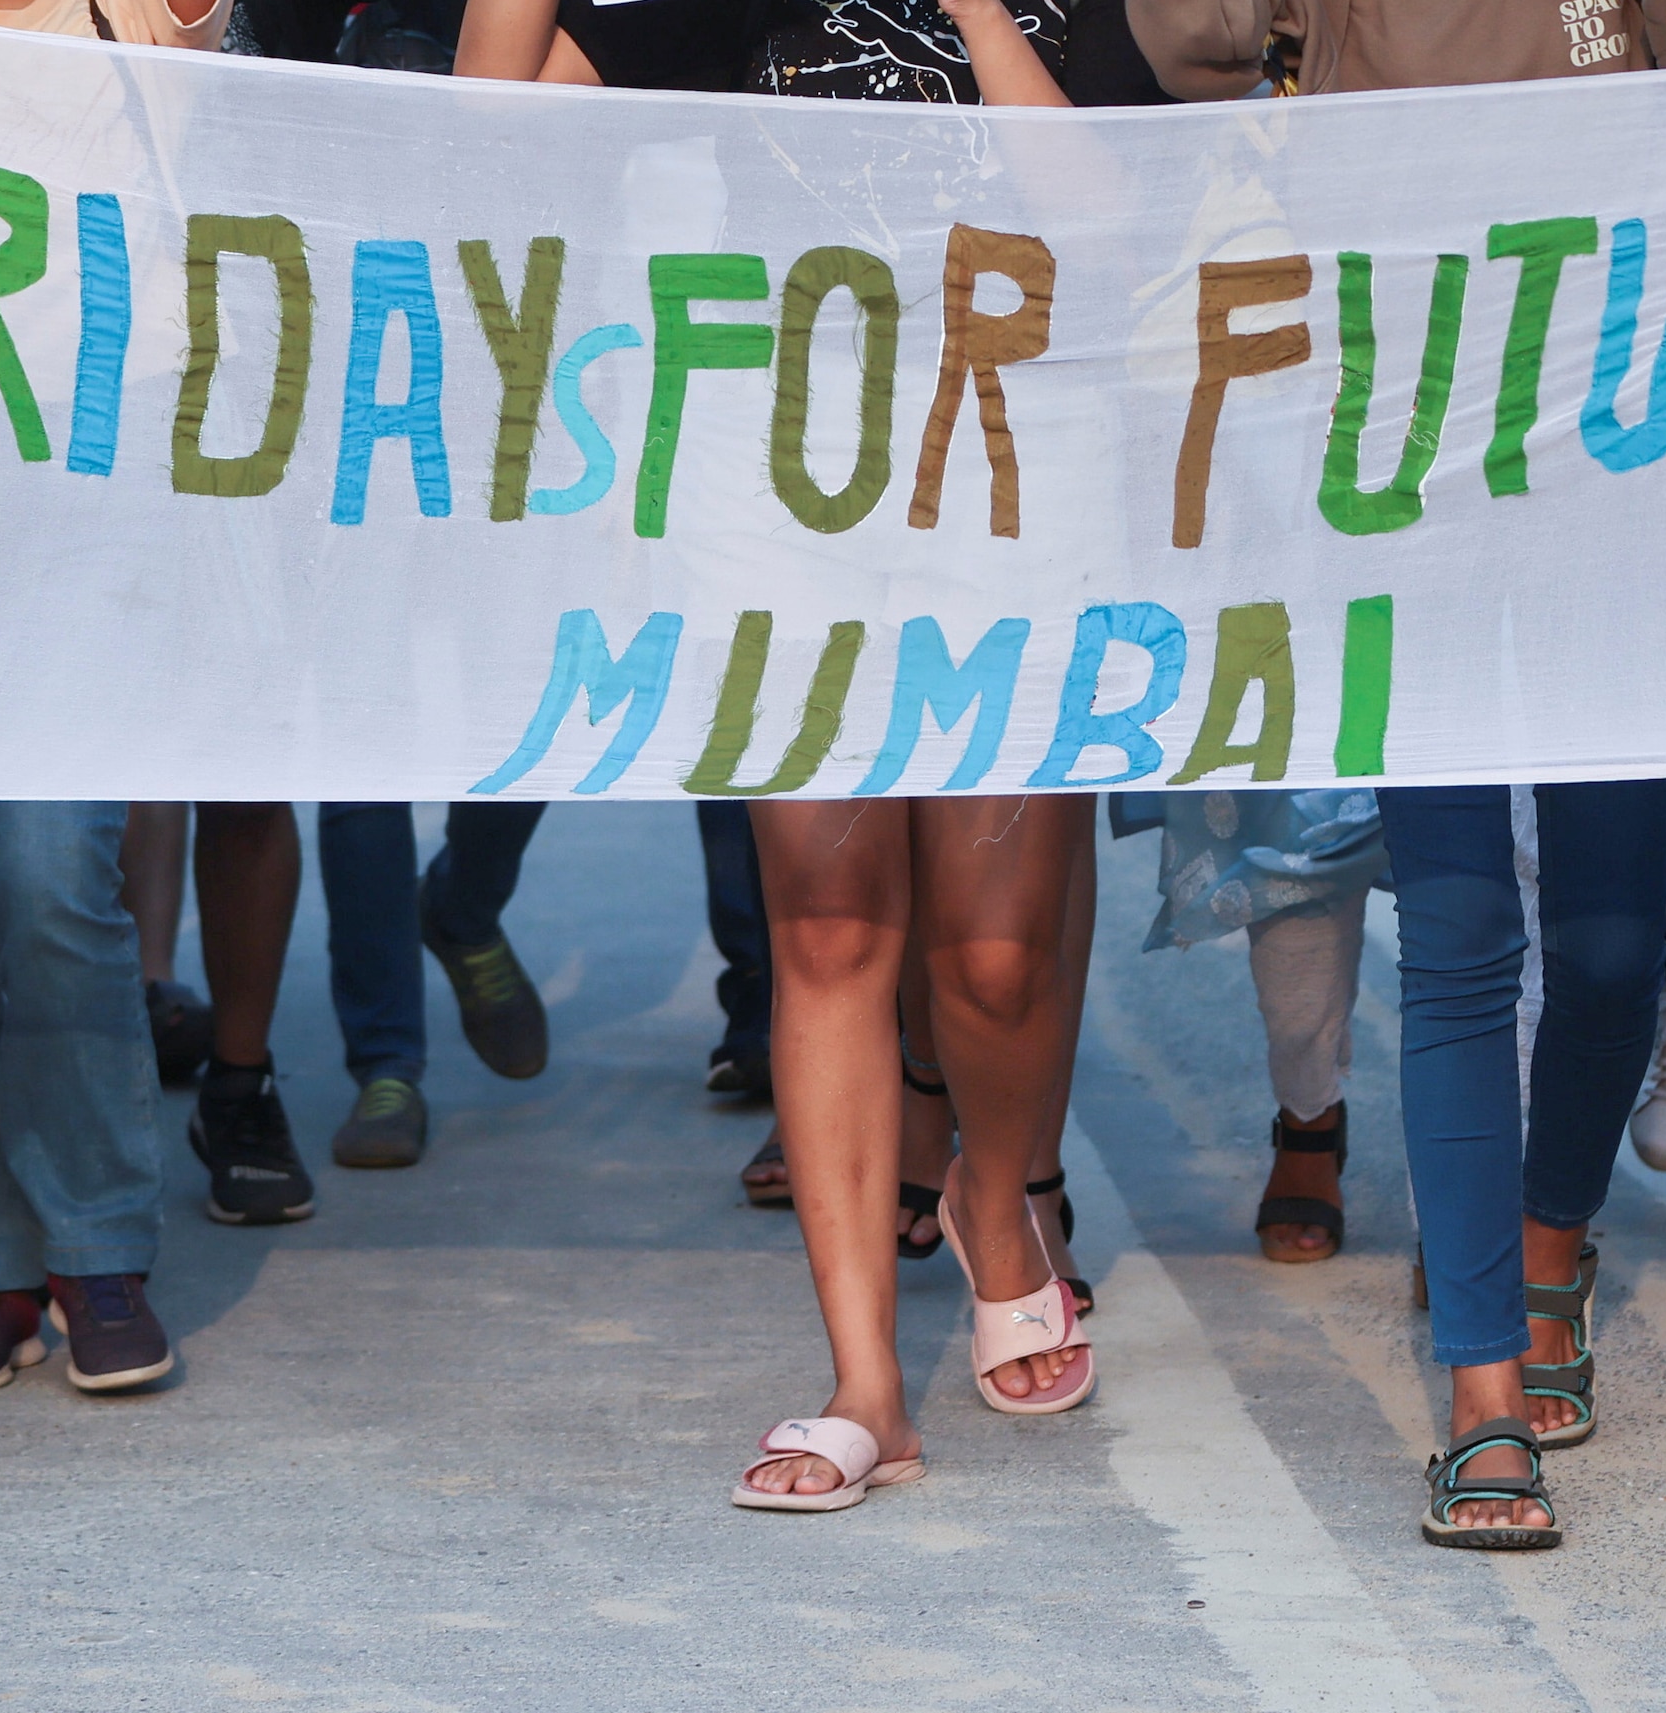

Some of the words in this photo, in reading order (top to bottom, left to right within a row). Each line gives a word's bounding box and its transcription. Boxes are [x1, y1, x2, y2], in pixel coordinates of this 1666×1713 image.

[1563, 15, 1606, 46] TO
[633, 222, 1059, 540] FOR
[467, 592, 1394, 797] MUMBAI
